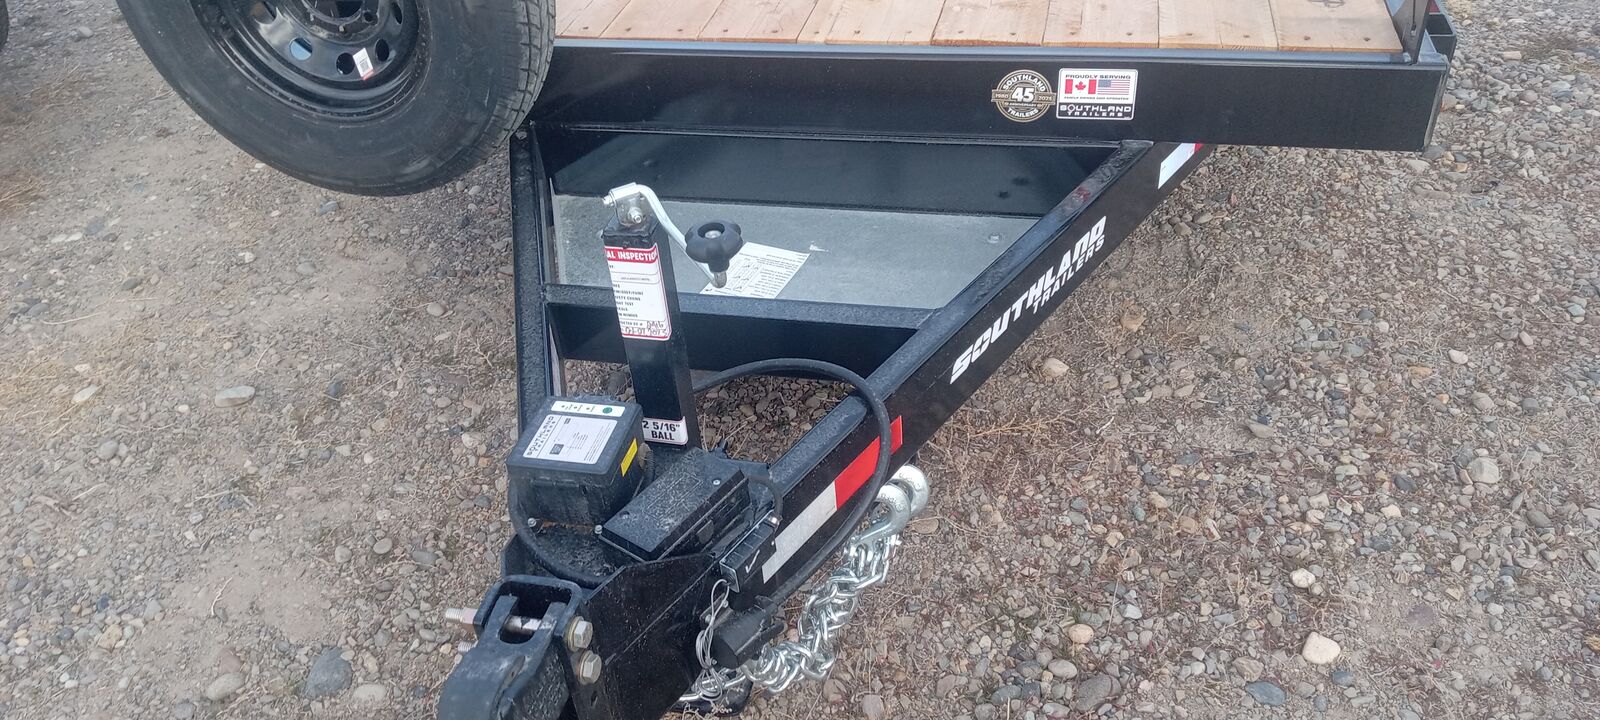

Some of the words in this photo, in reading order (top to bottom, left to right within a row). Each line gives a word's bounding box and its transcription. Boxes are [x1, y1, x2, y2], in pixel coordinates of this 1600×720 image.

[1002, 74, 1046, 92] SOUTHLAND
[1011, 87, 1035, 102] 45
[1007, 107, 1039, 118] TRAILERS
[1059, 103, 1132, 112] SOUTHLAND
[1033, 235, 1105, 314] TRAILERS
[950, 216, 1107, 385] SOUTHLAND
[642, 421, 650, 429] 2
[651, 431, 675, 441] BALL
